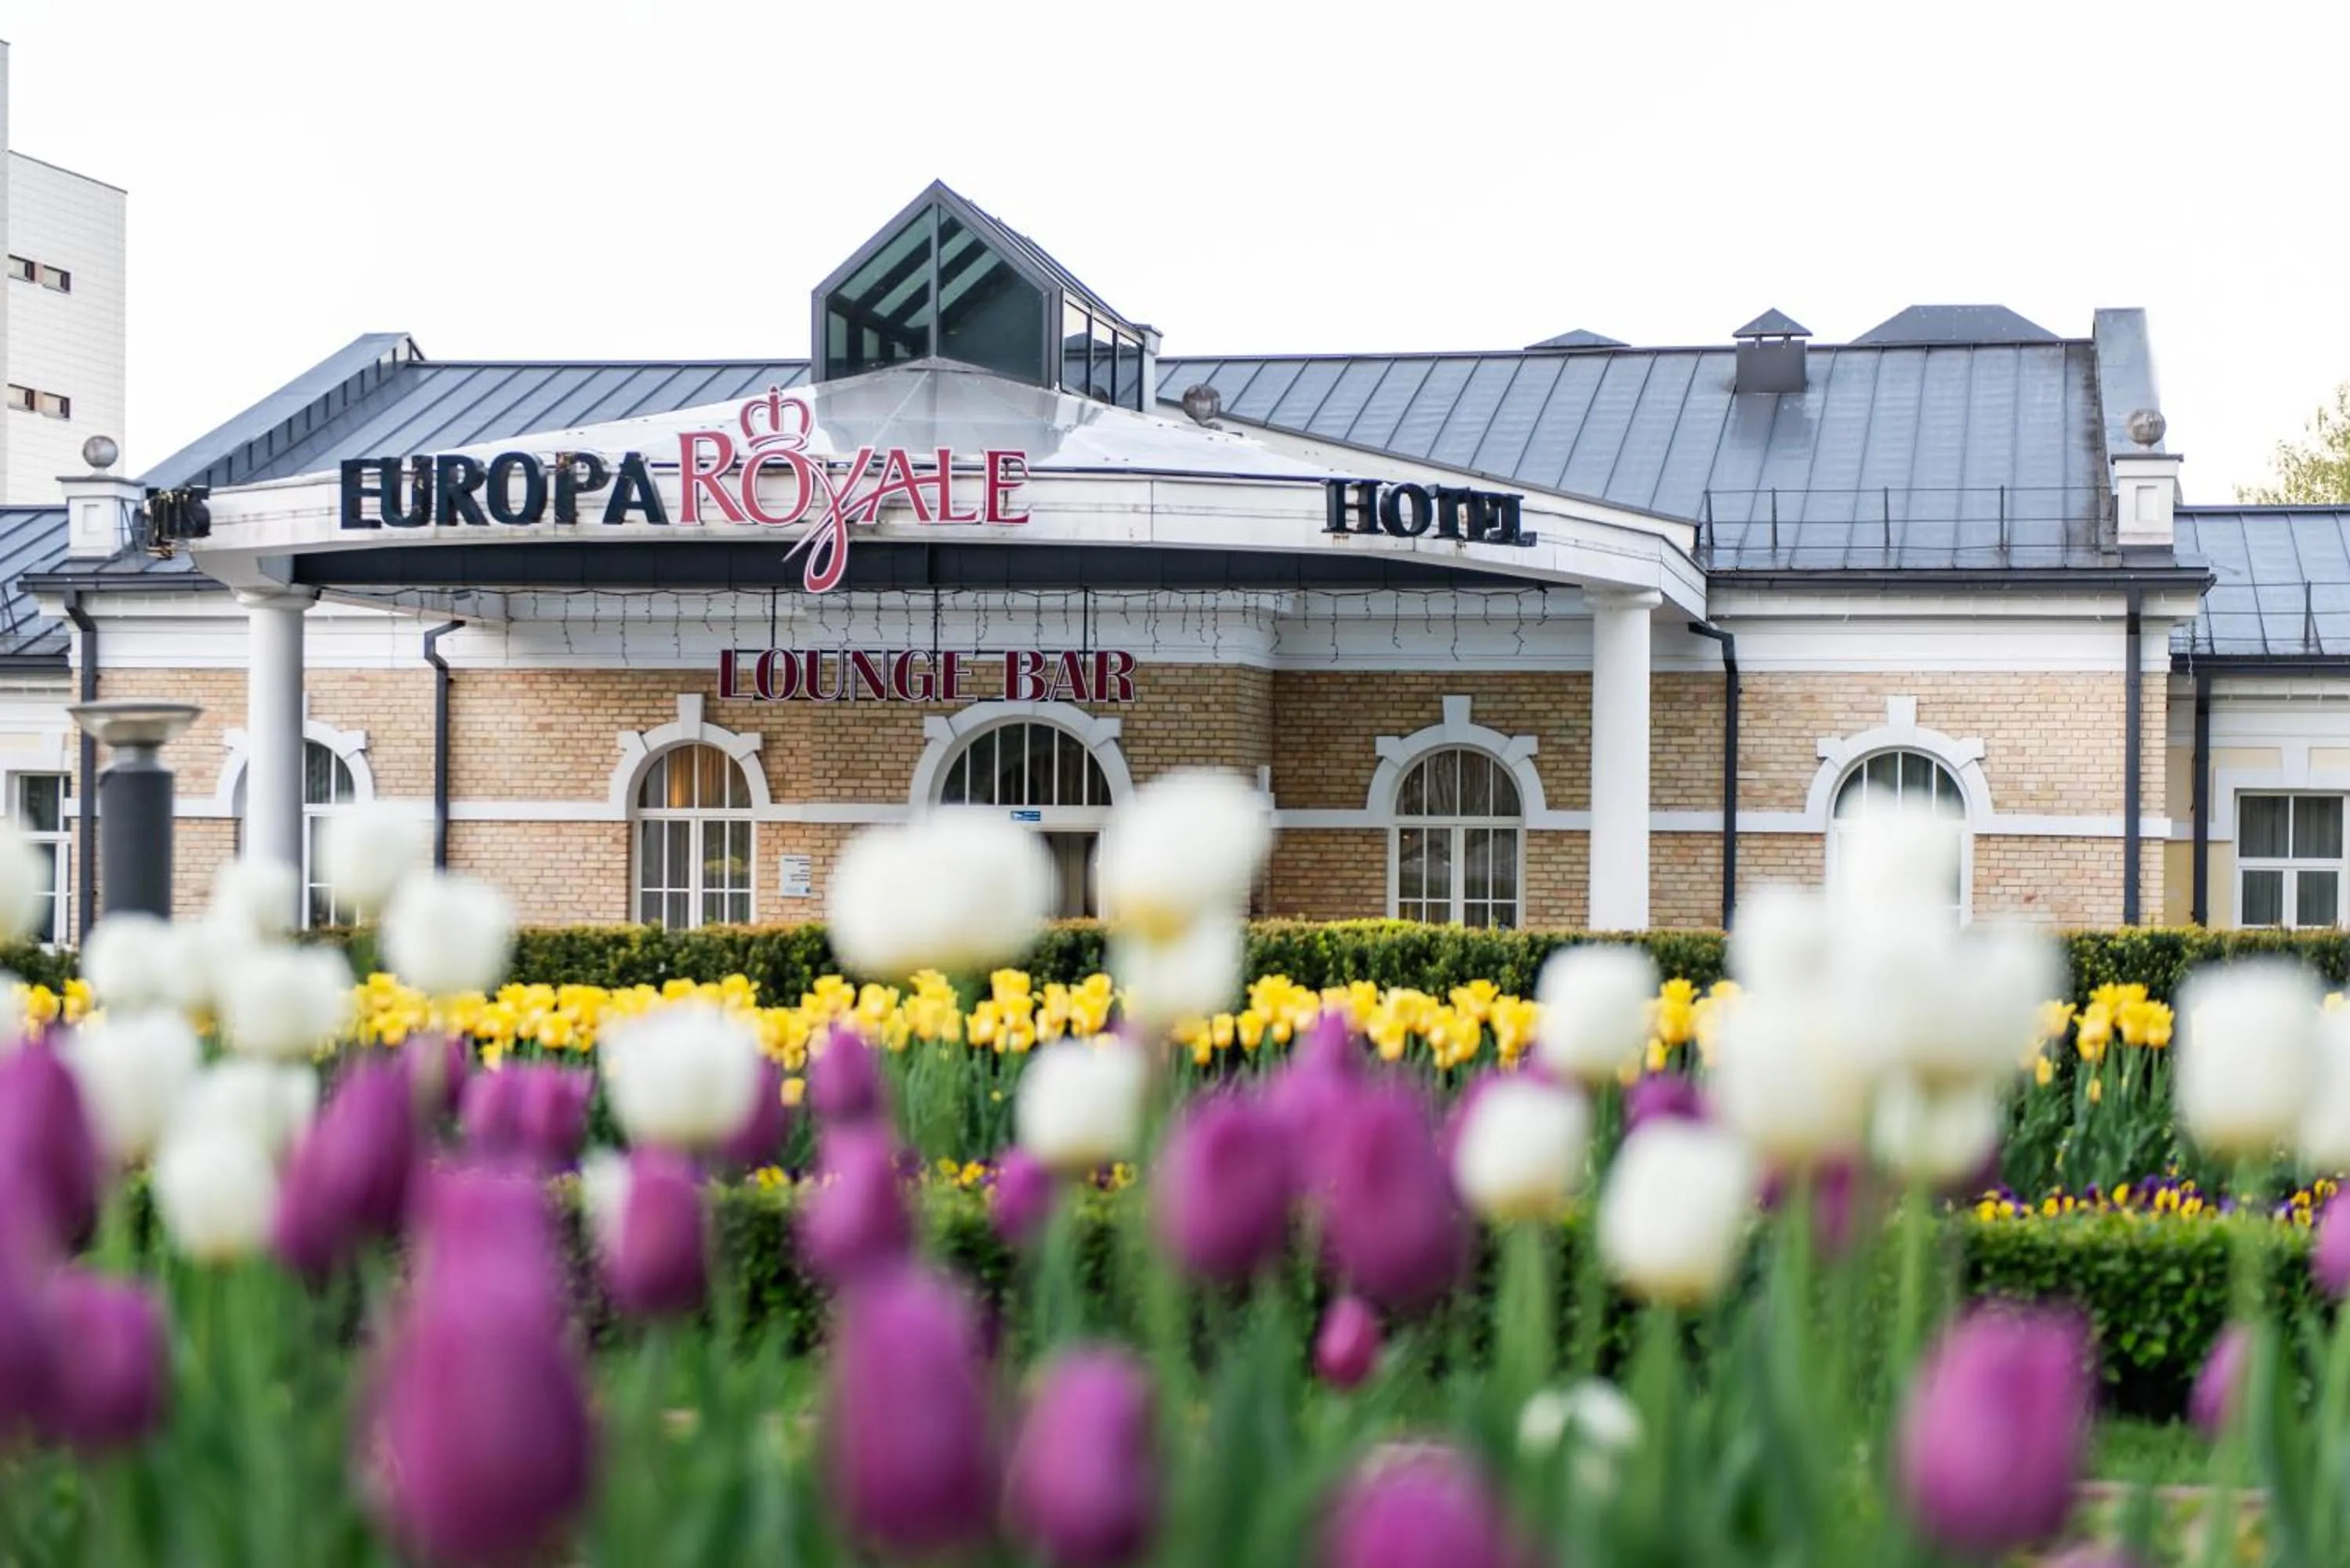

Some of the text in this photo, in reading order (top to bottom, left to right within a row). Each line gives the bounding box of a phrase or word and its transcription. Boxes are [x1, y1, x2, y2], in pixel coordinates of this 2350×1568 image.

[341, 451, 669, 529] EUROPA
[678, 431, 1032, 593] ROYALE
[1321, 479, 1537, 547] HOTEL
[718, 649, 1137, 703] LOUNGE BAR
